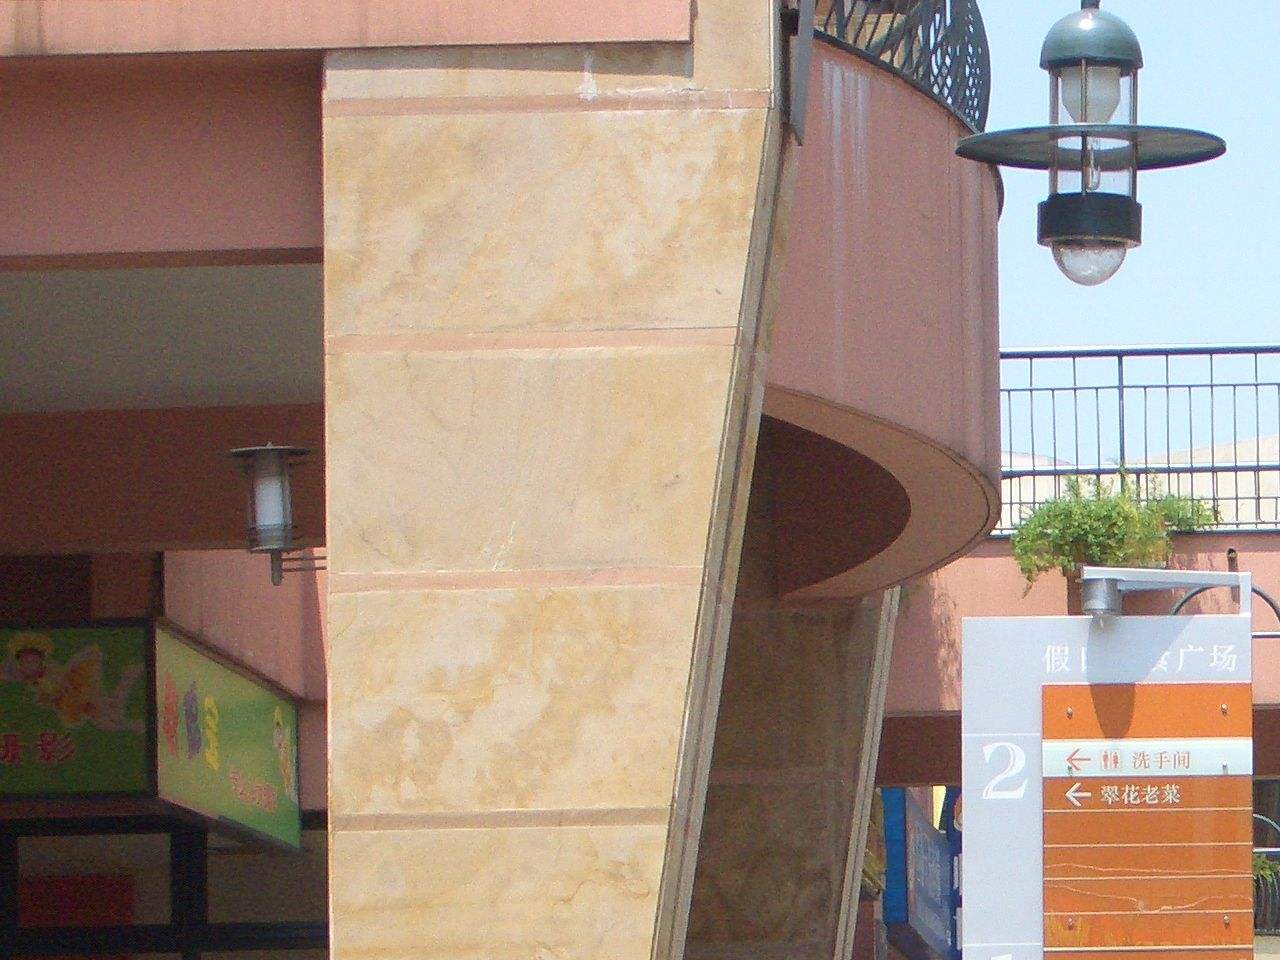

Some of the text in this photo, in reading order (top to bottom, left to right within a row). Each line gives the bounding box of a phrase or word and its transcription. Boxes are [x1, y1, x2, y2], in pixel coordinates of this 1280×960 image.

[982, 742, 1027, 800] 2
[1132, 751, 1190, 769] 洗手间
